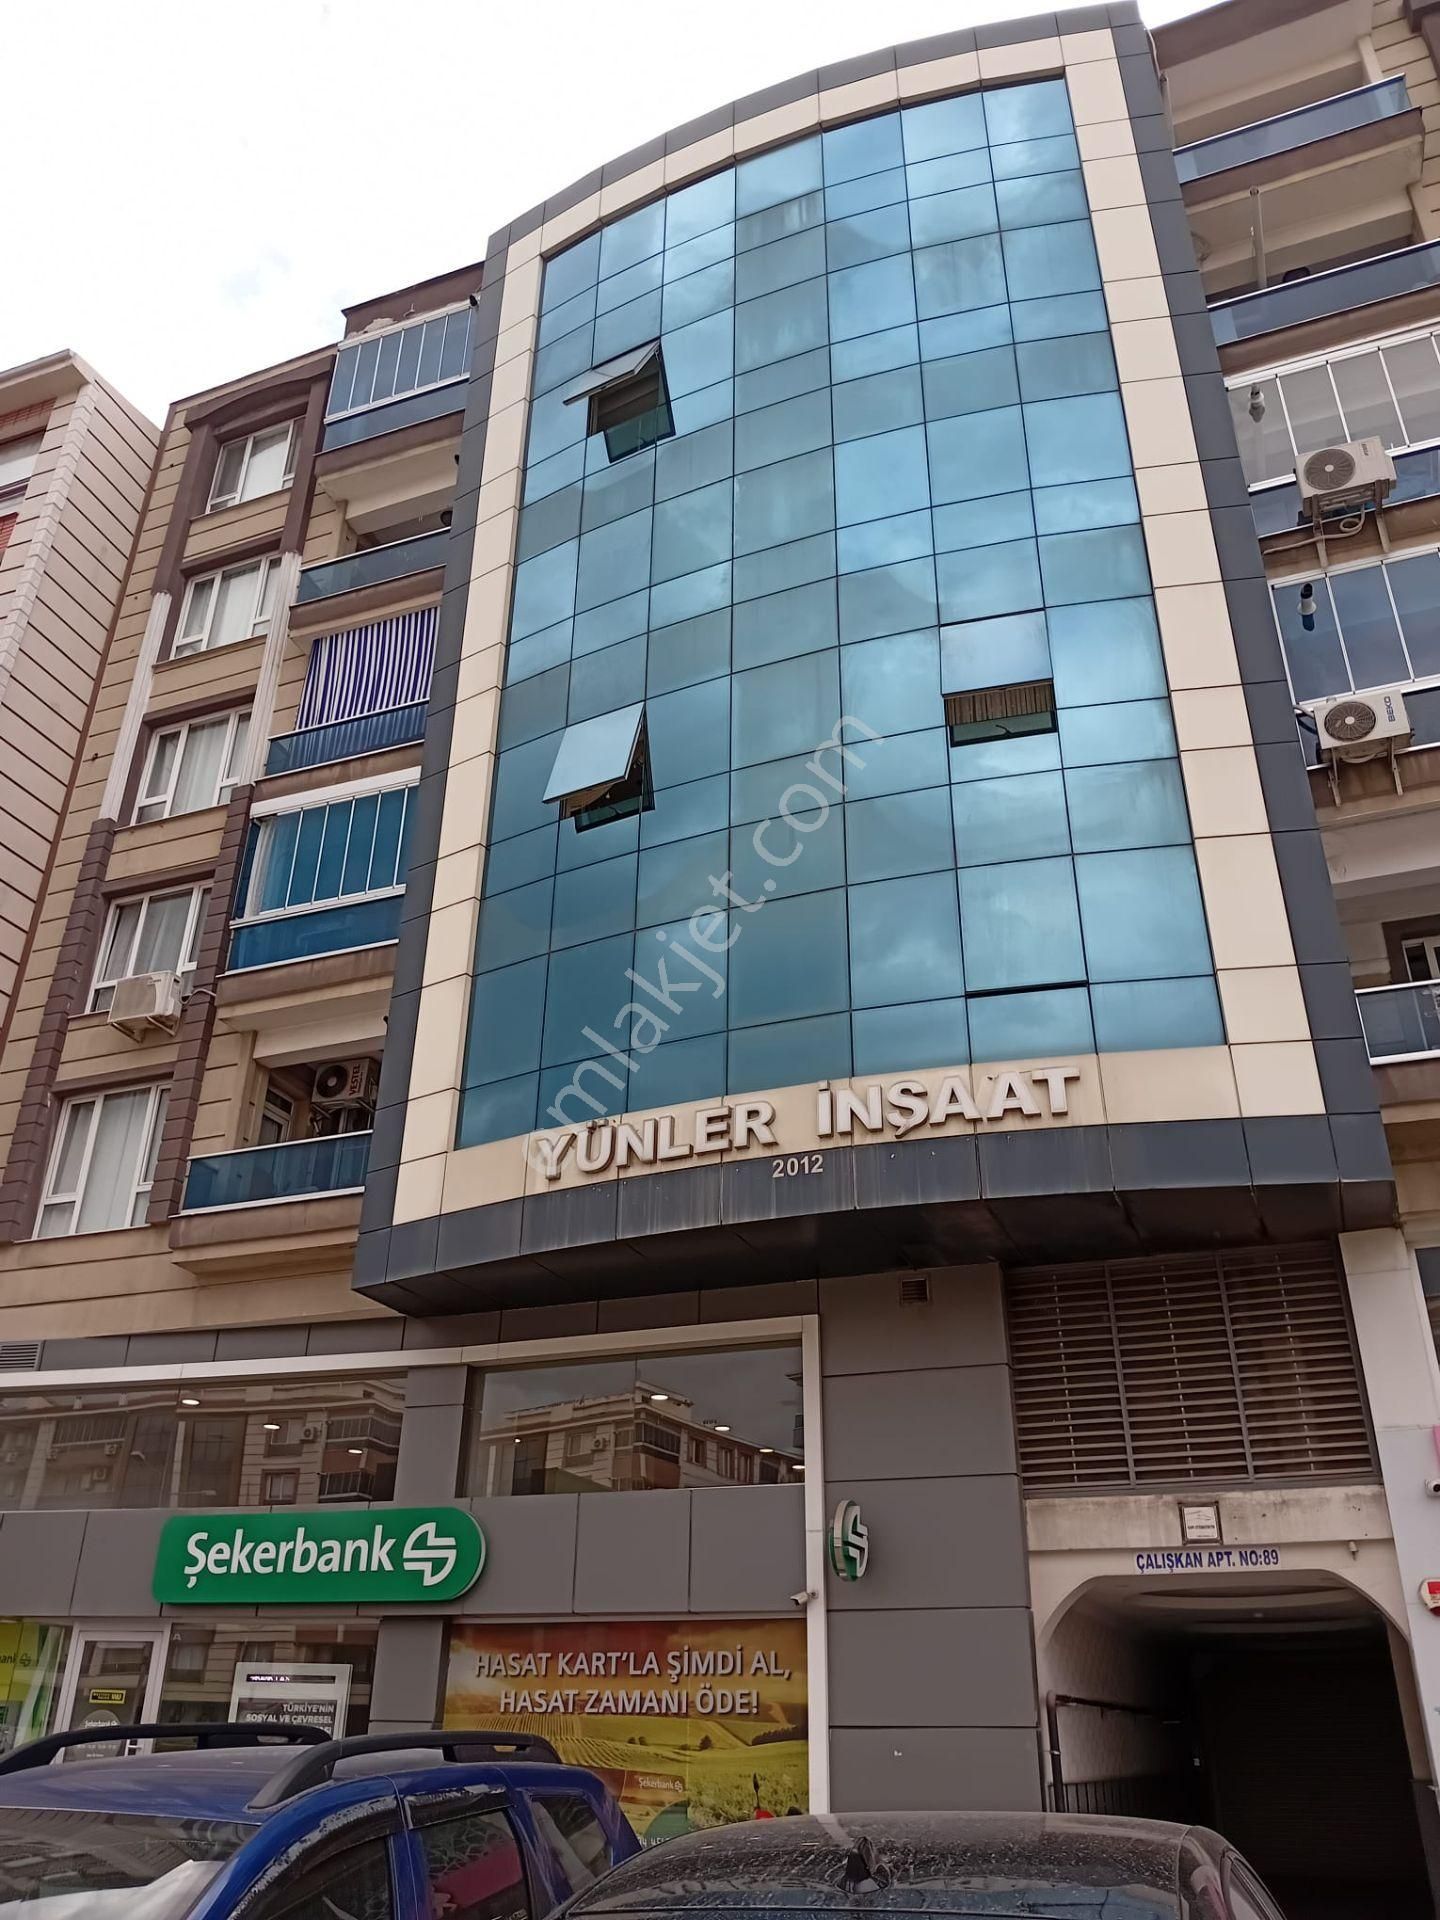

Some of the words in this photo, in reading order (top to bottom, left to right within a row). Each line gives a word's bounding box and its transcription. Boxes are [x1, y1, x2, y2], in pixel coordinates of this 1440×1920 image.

[1384, 696, 1396, 722] BEKO
[349, 1063, 361, 1096] VESTEL
[537, 1100, 777, 1181] YÜNLER
[817, 1066, 1081, 1138] İNŞAAT
[772, 1154, 824, 1179] 2012
[183, 1523, 397, 1589] Şekerbank
[1136, 1551, 1203, 1574] ÇALIŞKAN
[1207, 1550, 1236, 1568] APT.
[1239, 1549, 1279, 1566] NO:89
[475, 1651, 553, 1678] HASAT
[557, 1650, 661, 1677] KART'LA
[667, 1644, 744, 1684] ŞİMDİ
[749, 1651, 793, 1681] AL,
[282, 1702, 335, 1713] TÜRKİYE'NİN
[500, 1689, 580, 1715] HASAT
[584, 1688, 688, 1715] ZAMANI
[695, 1683, 760, 1715] ÖDE!
[246, 1713, 278, 1723] SOSYAL
[280, 1714, 291, 1722] VE
[291, 1714, 334, 1725] ÇEVRESEL
